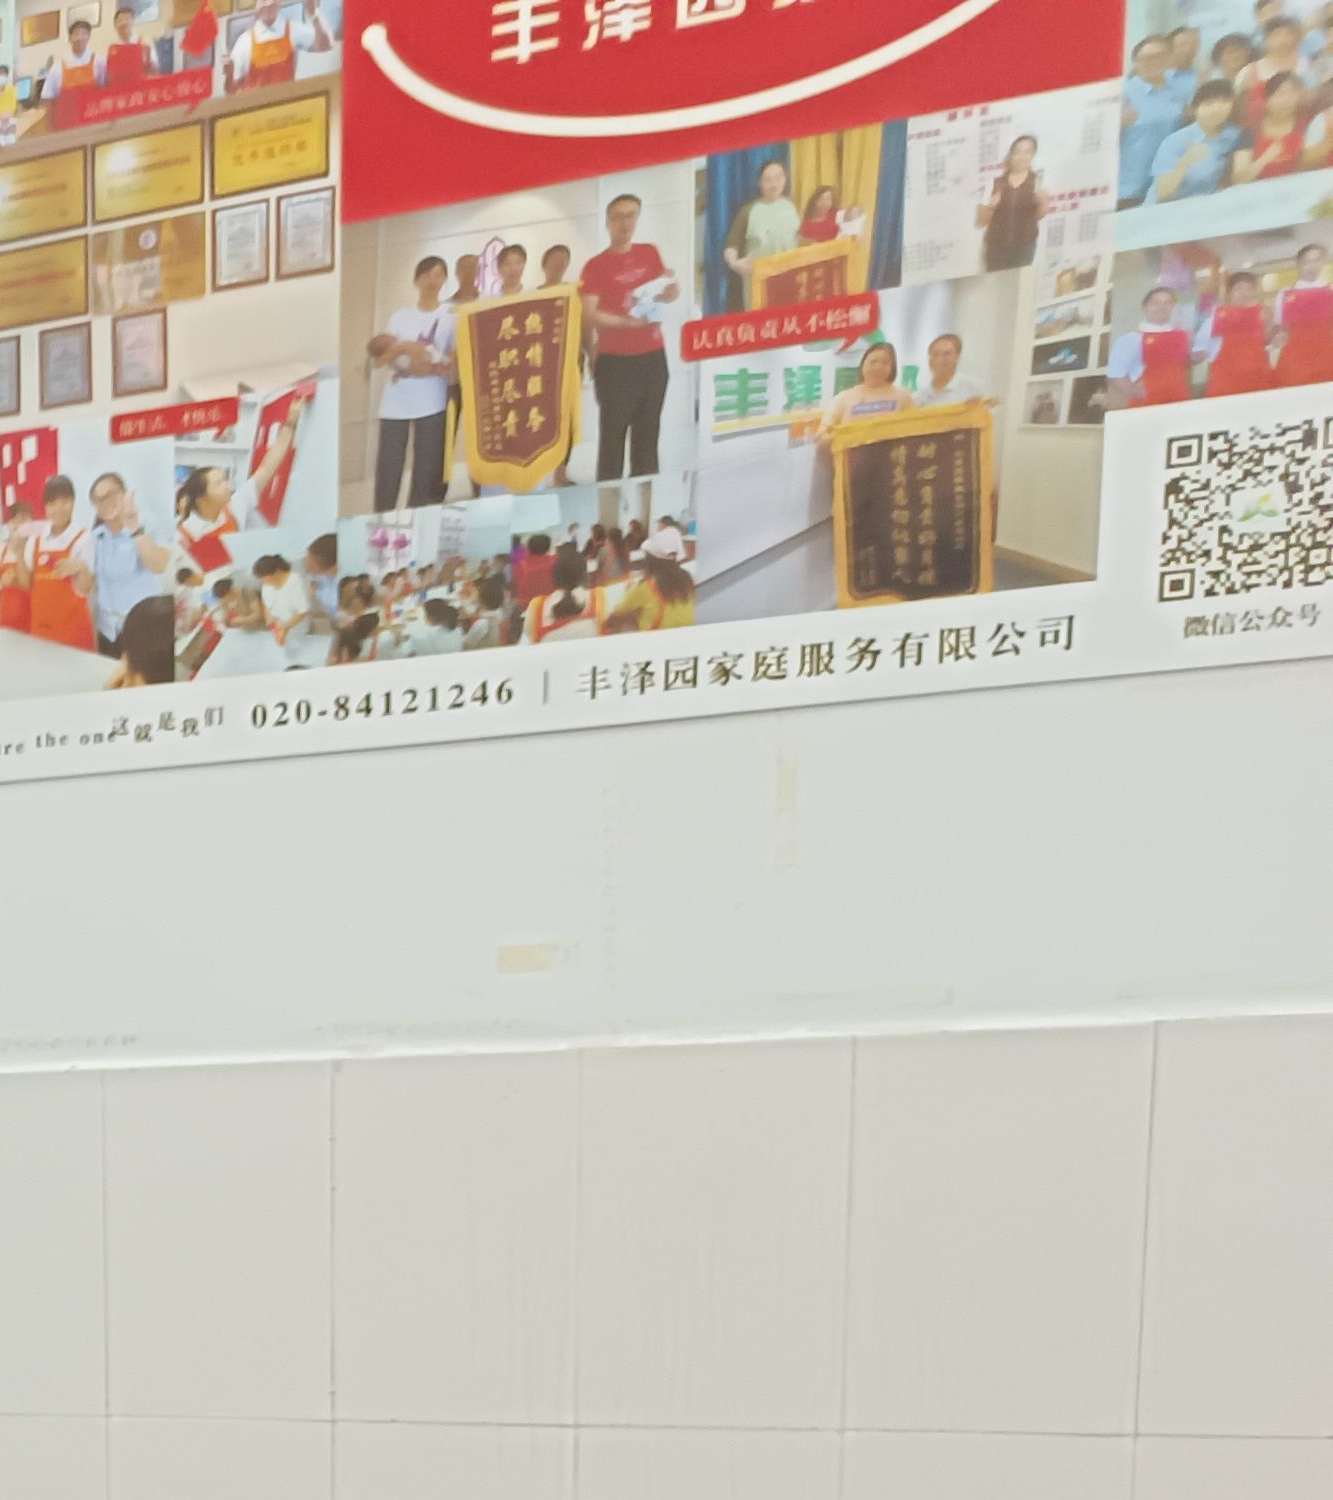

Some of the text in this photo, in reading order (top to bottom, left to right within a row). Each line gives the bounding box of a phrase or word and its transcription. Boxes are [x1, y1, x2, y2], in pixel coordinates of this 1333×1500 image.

[1183, 602, 1321, 639] 微信公众号
[576, 614, 1076, 700] 丰泽园家庭服务有限公司
[250, 677, 515, 730] 020-84121246
[36, 731, 70, 750] the
[79, 726, 116, 746] one
